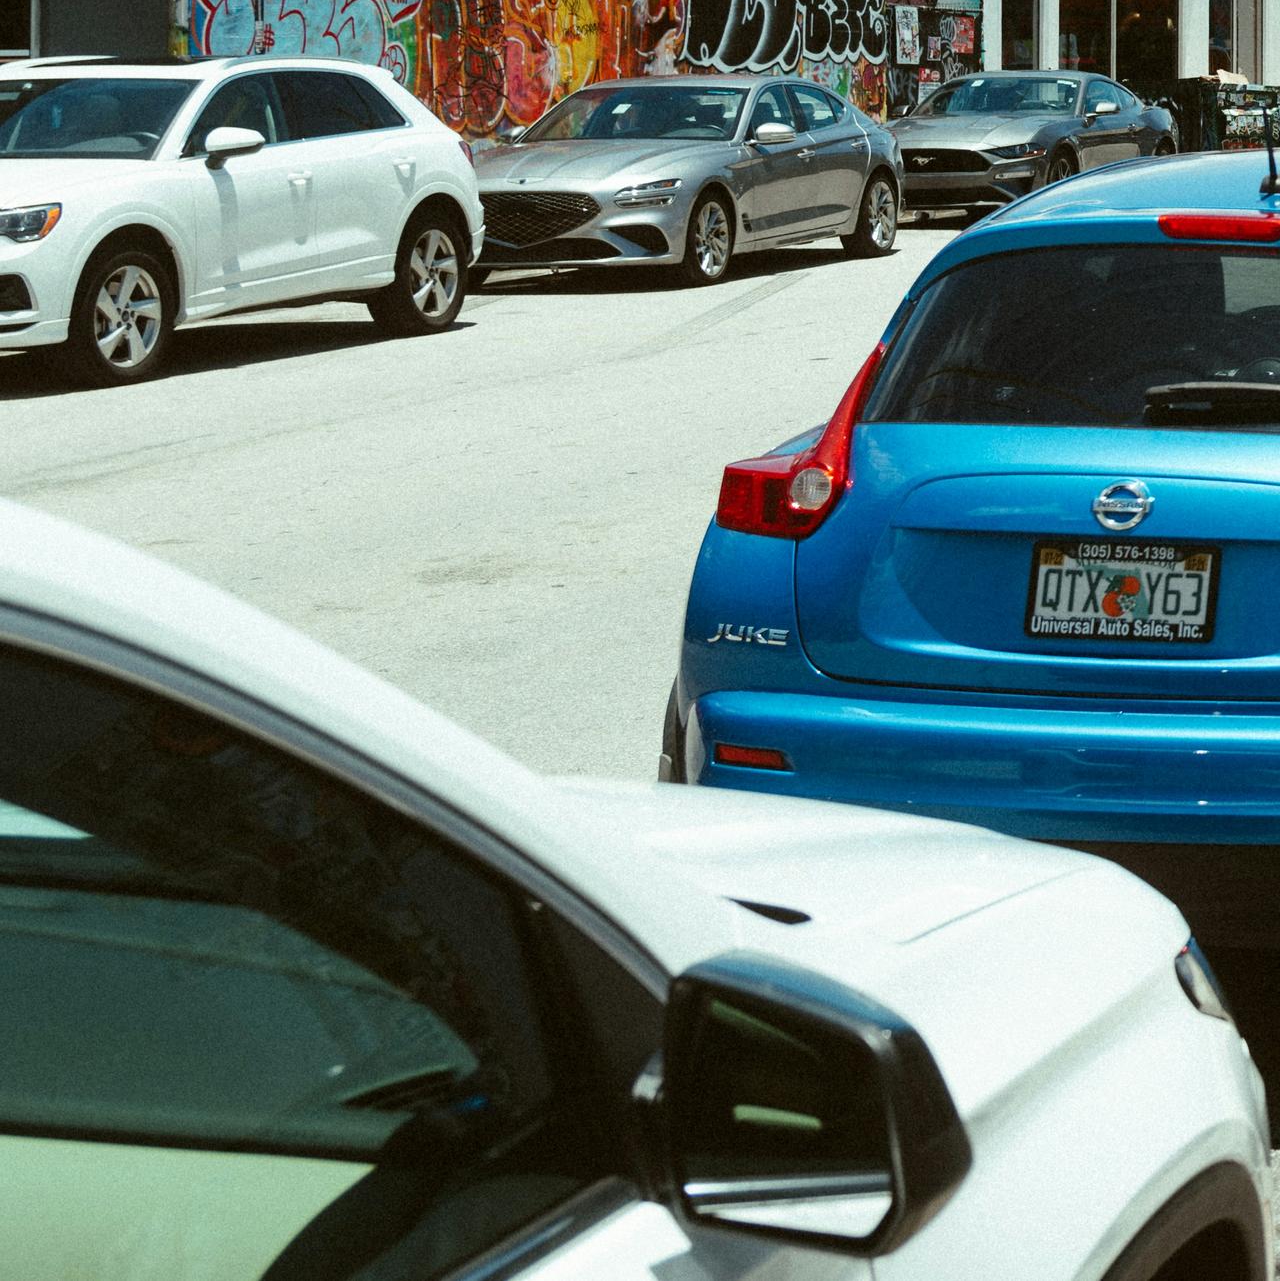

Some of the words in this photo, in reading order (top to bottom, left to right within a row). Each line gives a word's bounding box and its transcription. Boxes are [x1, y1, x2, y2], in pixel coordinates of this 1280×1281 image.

[1078, 543, 1112, 559] (305)
[1115, 545, 1176, 561] 576-1398
[1041, 568, 1105, 613] QTX
[1146, 572, 1204, 617] Y63
[706, 623, 790, 646] JUKE
[1031, 615, 1095, 635] Universal
[1098, 618, 1129, 636] Auto
[1133, 619, 1174, 640] Sales,
[1177, 620, 1204, 638] Inc.
